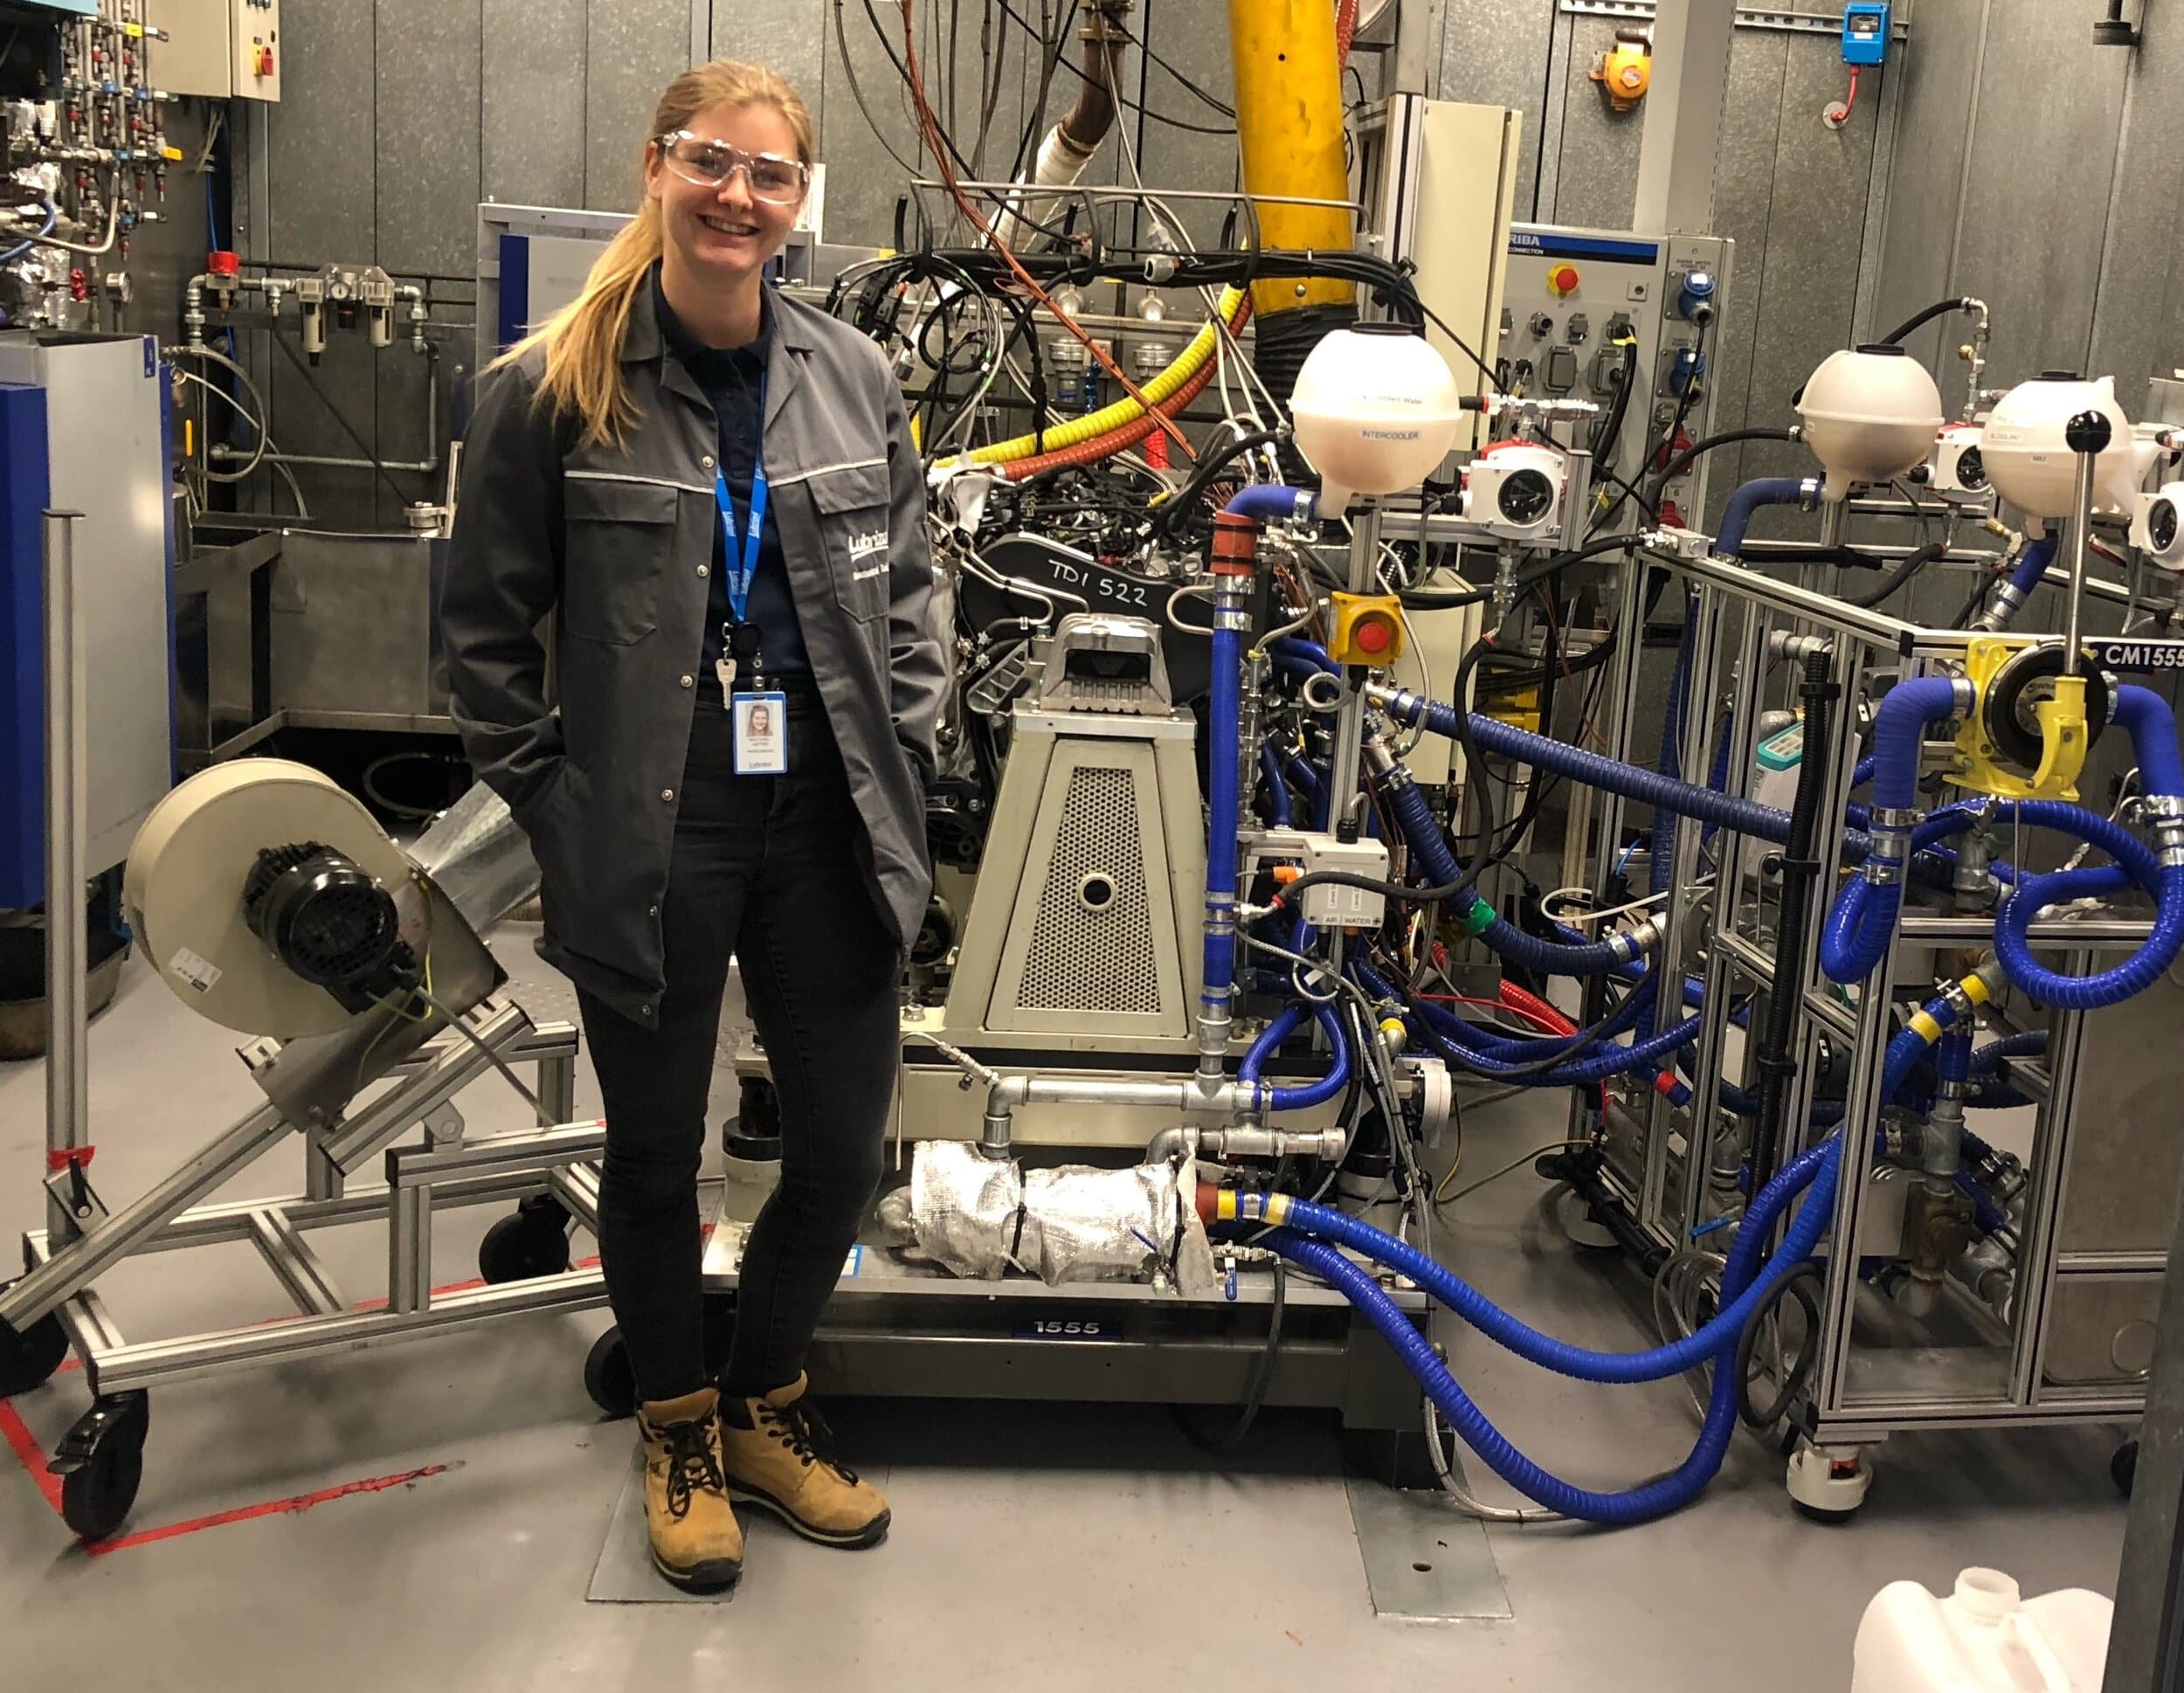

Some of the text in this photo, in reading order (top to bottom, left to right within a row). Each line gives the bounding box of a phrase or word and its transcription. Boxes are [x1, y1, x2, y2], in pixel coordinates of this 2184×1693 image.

[1510, 233, 1541, 246] RIBA
[1362, 430, 1419, 440] INTERCOOLER
[1047, 558, 1089, 587] TDI
[2105, 645, 2184, 668] CM1555
[1033, 1320, 1100, 1334] 1555
